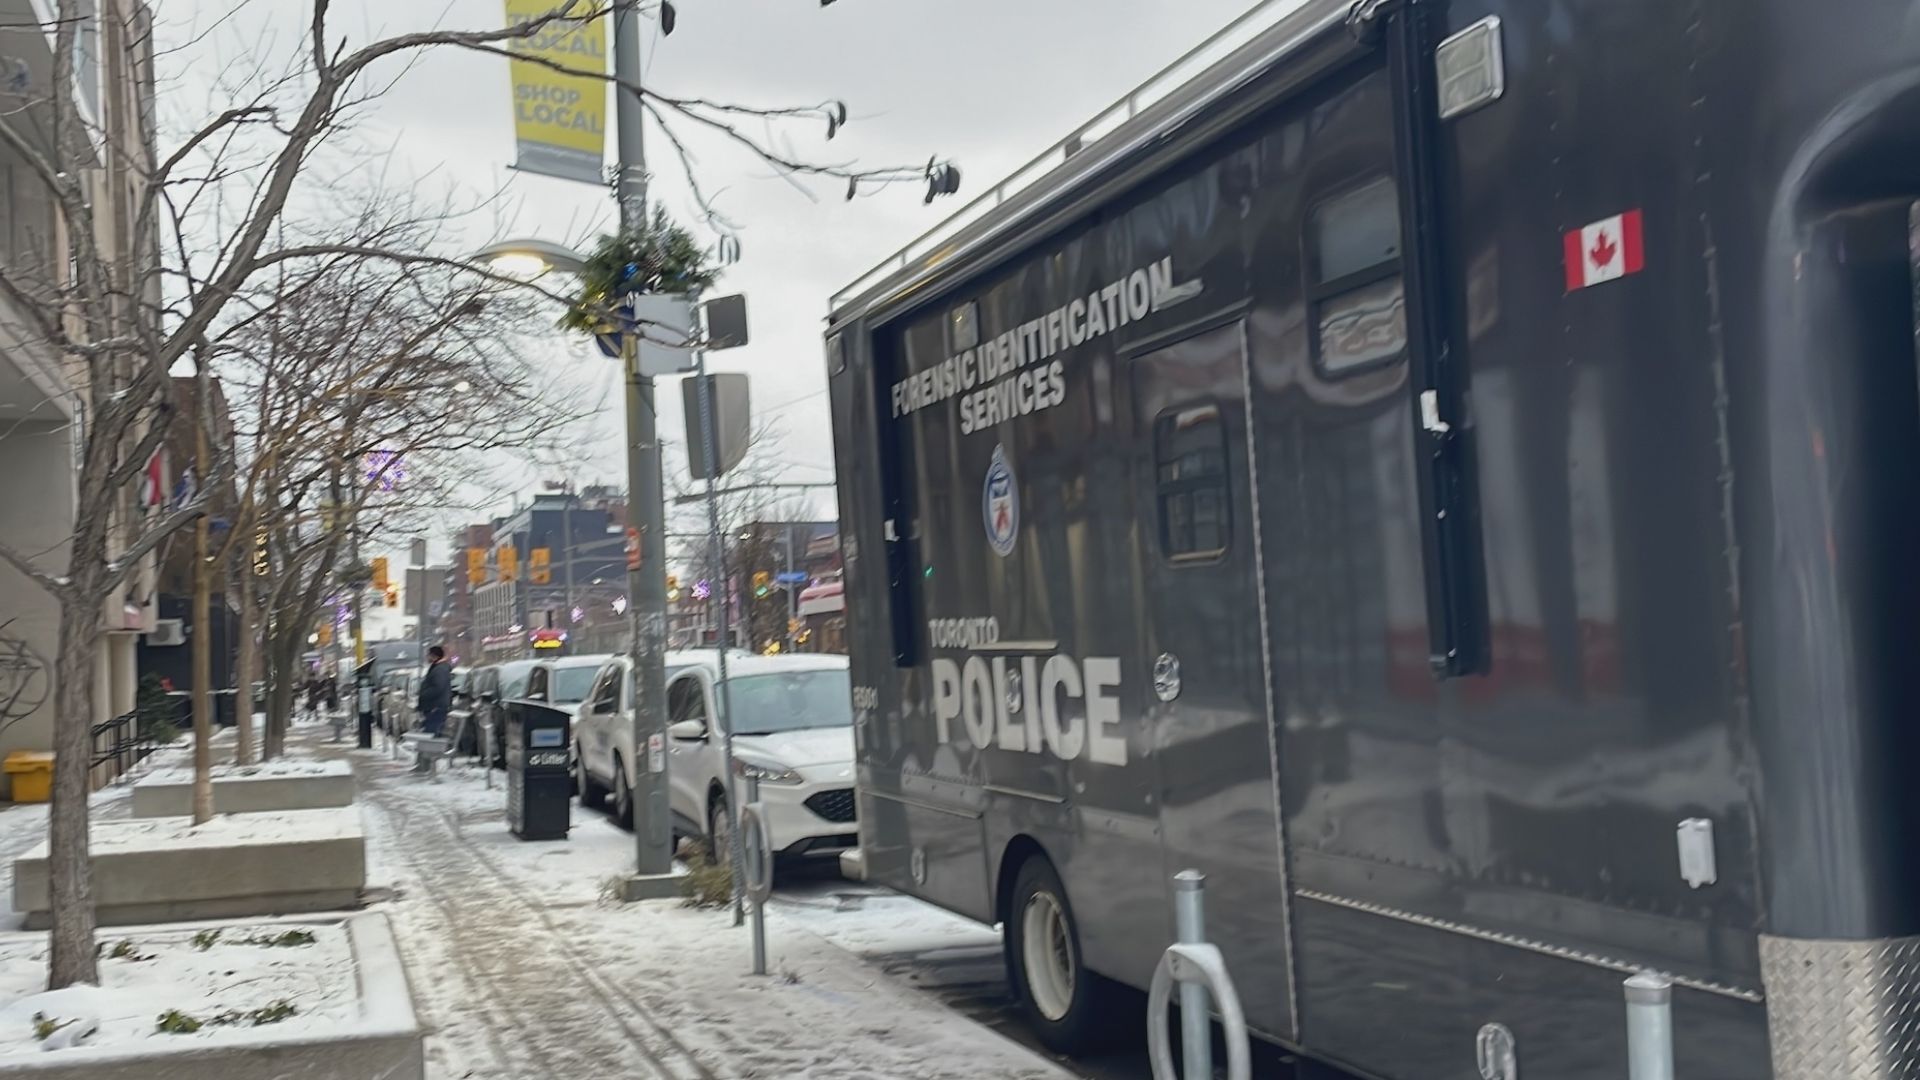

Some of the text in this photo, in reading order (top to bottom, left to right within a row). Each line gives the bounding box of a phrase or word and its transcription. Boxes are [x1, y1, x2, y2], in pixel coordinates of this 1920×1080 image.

[516, 83, 581, 105] SHOP
[517, 104, 603, 135] LOCAL
[891, 255, 1174, 419] FORENSIC IDENTIFICATION
[959, 359, 1066, 436] SERVICES
[928, 615, 1000, 649] TORONTO
[931, 653, 1128, 767] POLICE
